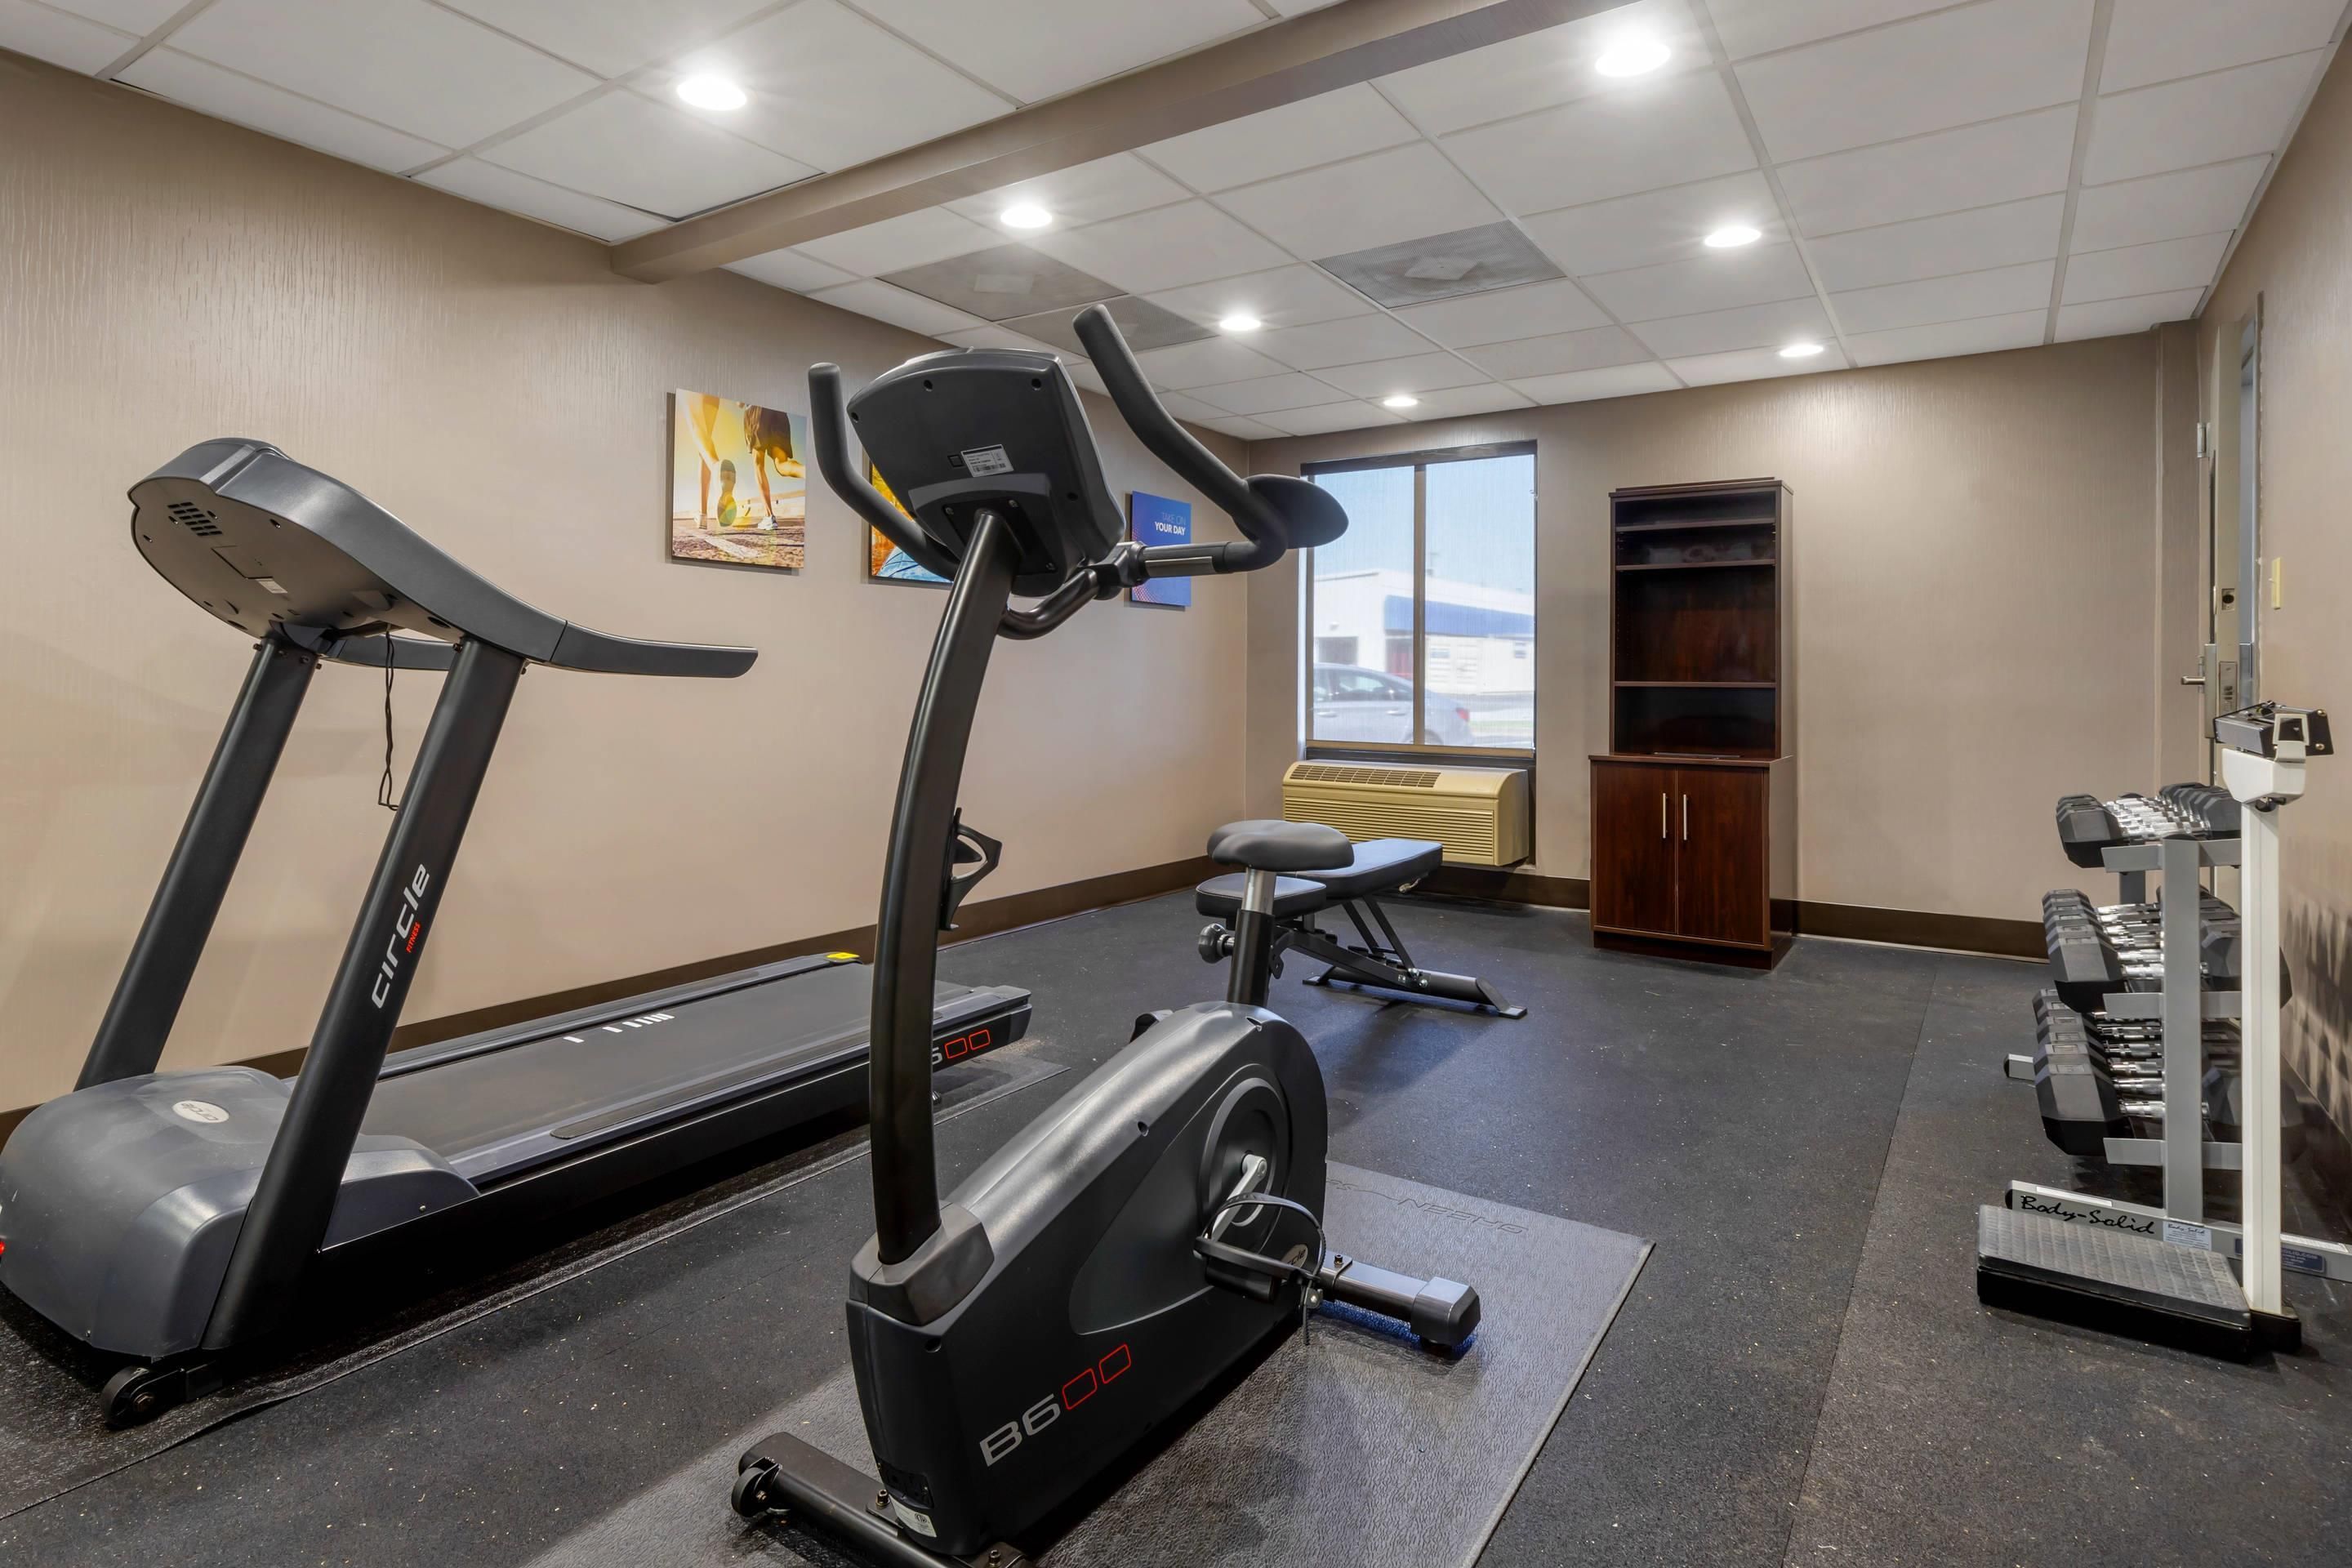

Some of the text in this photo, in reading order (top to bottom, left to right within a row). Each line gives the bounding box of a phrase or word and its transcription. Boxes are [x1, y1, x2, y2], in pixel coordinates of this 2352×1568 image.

[1155, 521, 1185, 536] YOUR DAY
[1162, 512, 1186, 525] TAKE ON
[372, 863, 430, 1009] circle
[406, 921, 421, 954] FITNESS
[2020, 1196, 2154, 1235] Body-Solid
[979, 1343, 1132, 1467] B600
